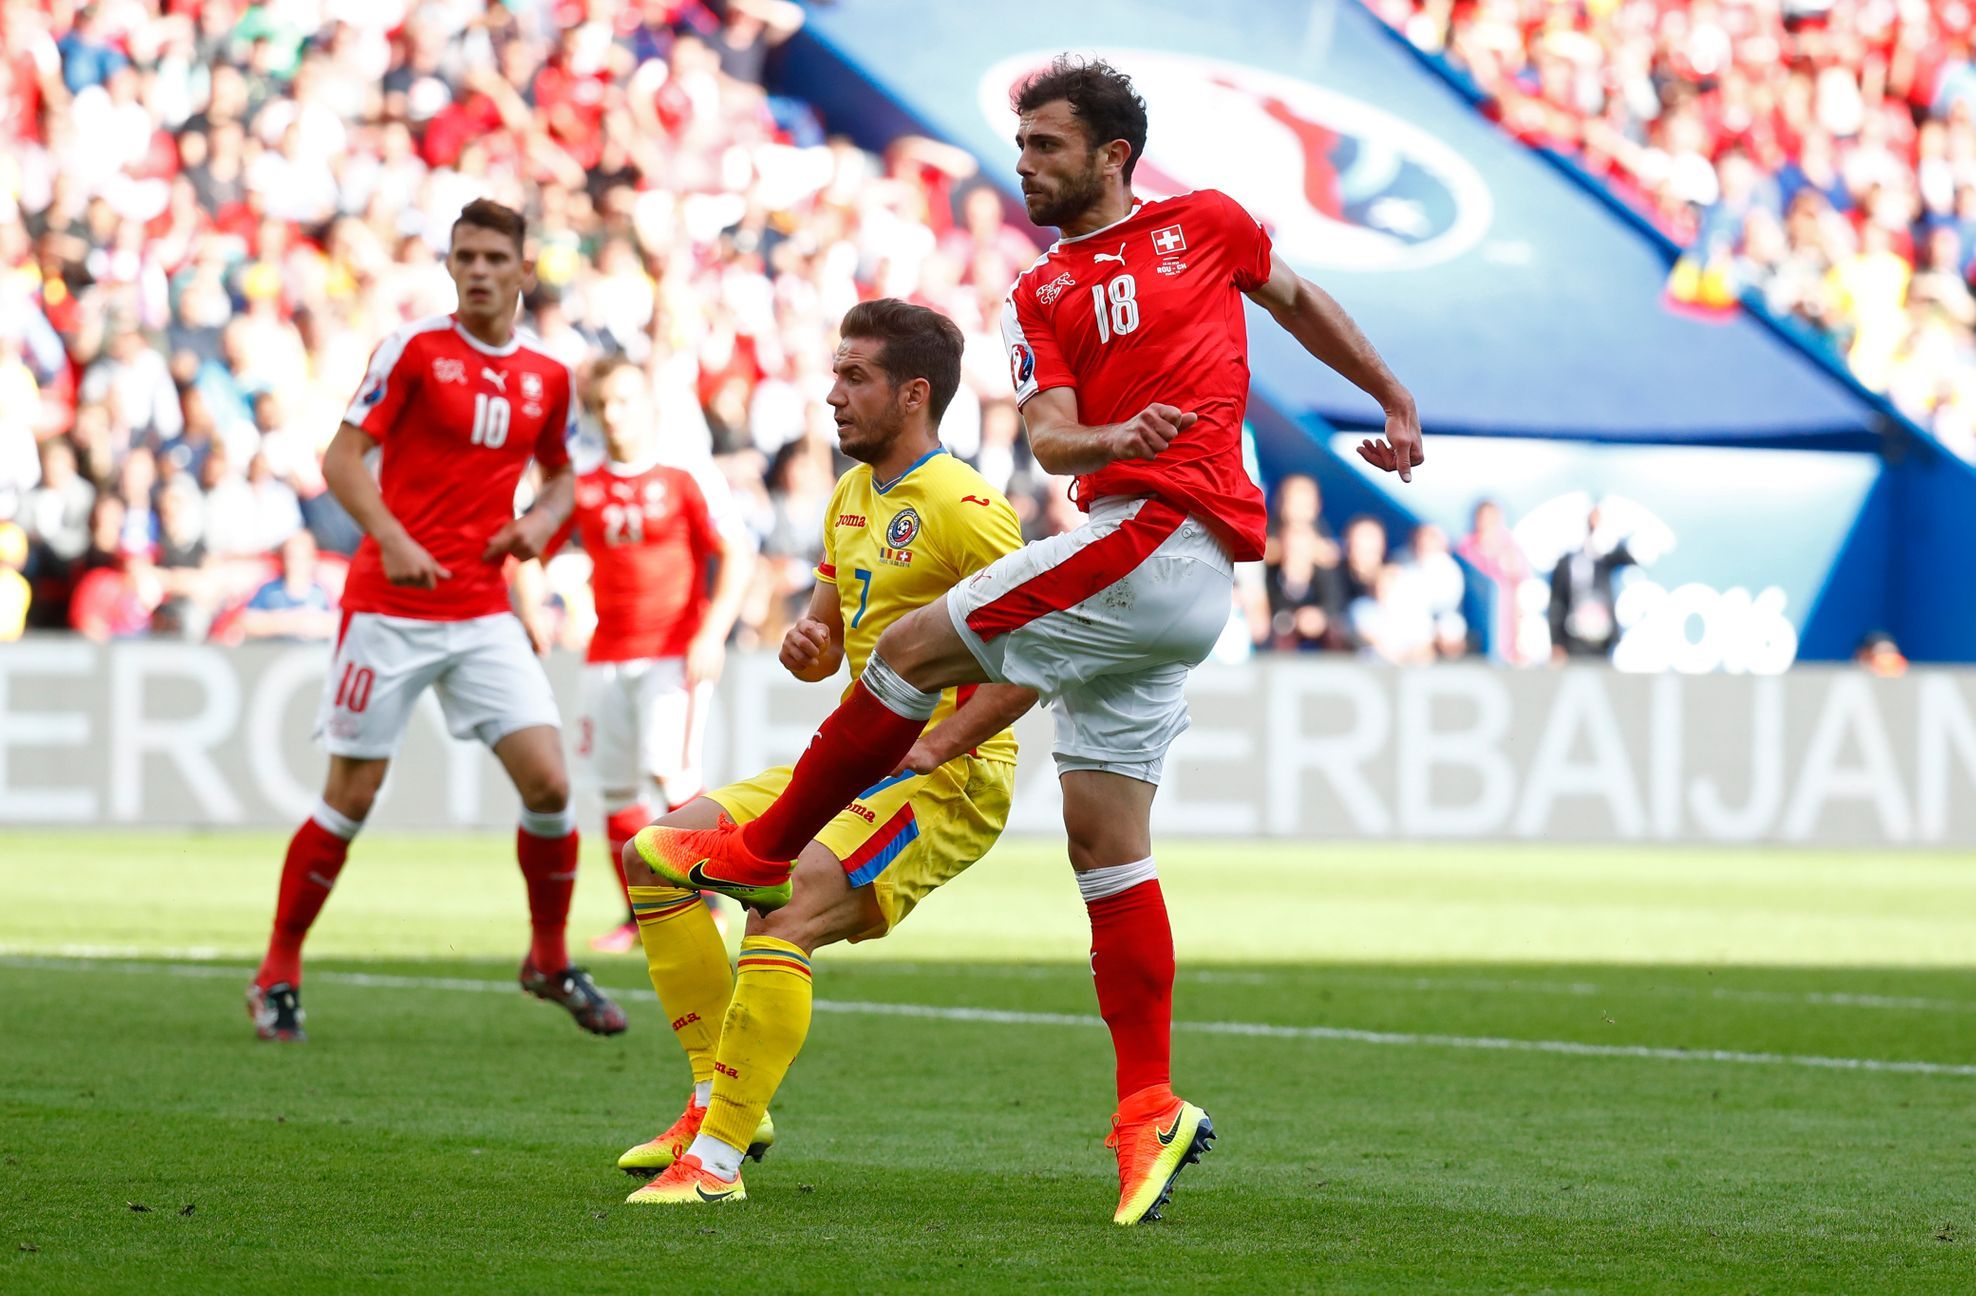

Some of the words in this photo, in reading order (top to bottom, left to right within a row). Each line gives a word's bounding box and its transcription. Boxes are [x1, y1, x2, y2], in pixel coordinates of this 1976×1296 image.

[1091, 274, 1140, 344] 18
[470, 393, 511, 449] 10
[851, 568, 872, 629] 7
[1613, 580, 1798, 676] 2016
[335, 660, 376, 714] 10
